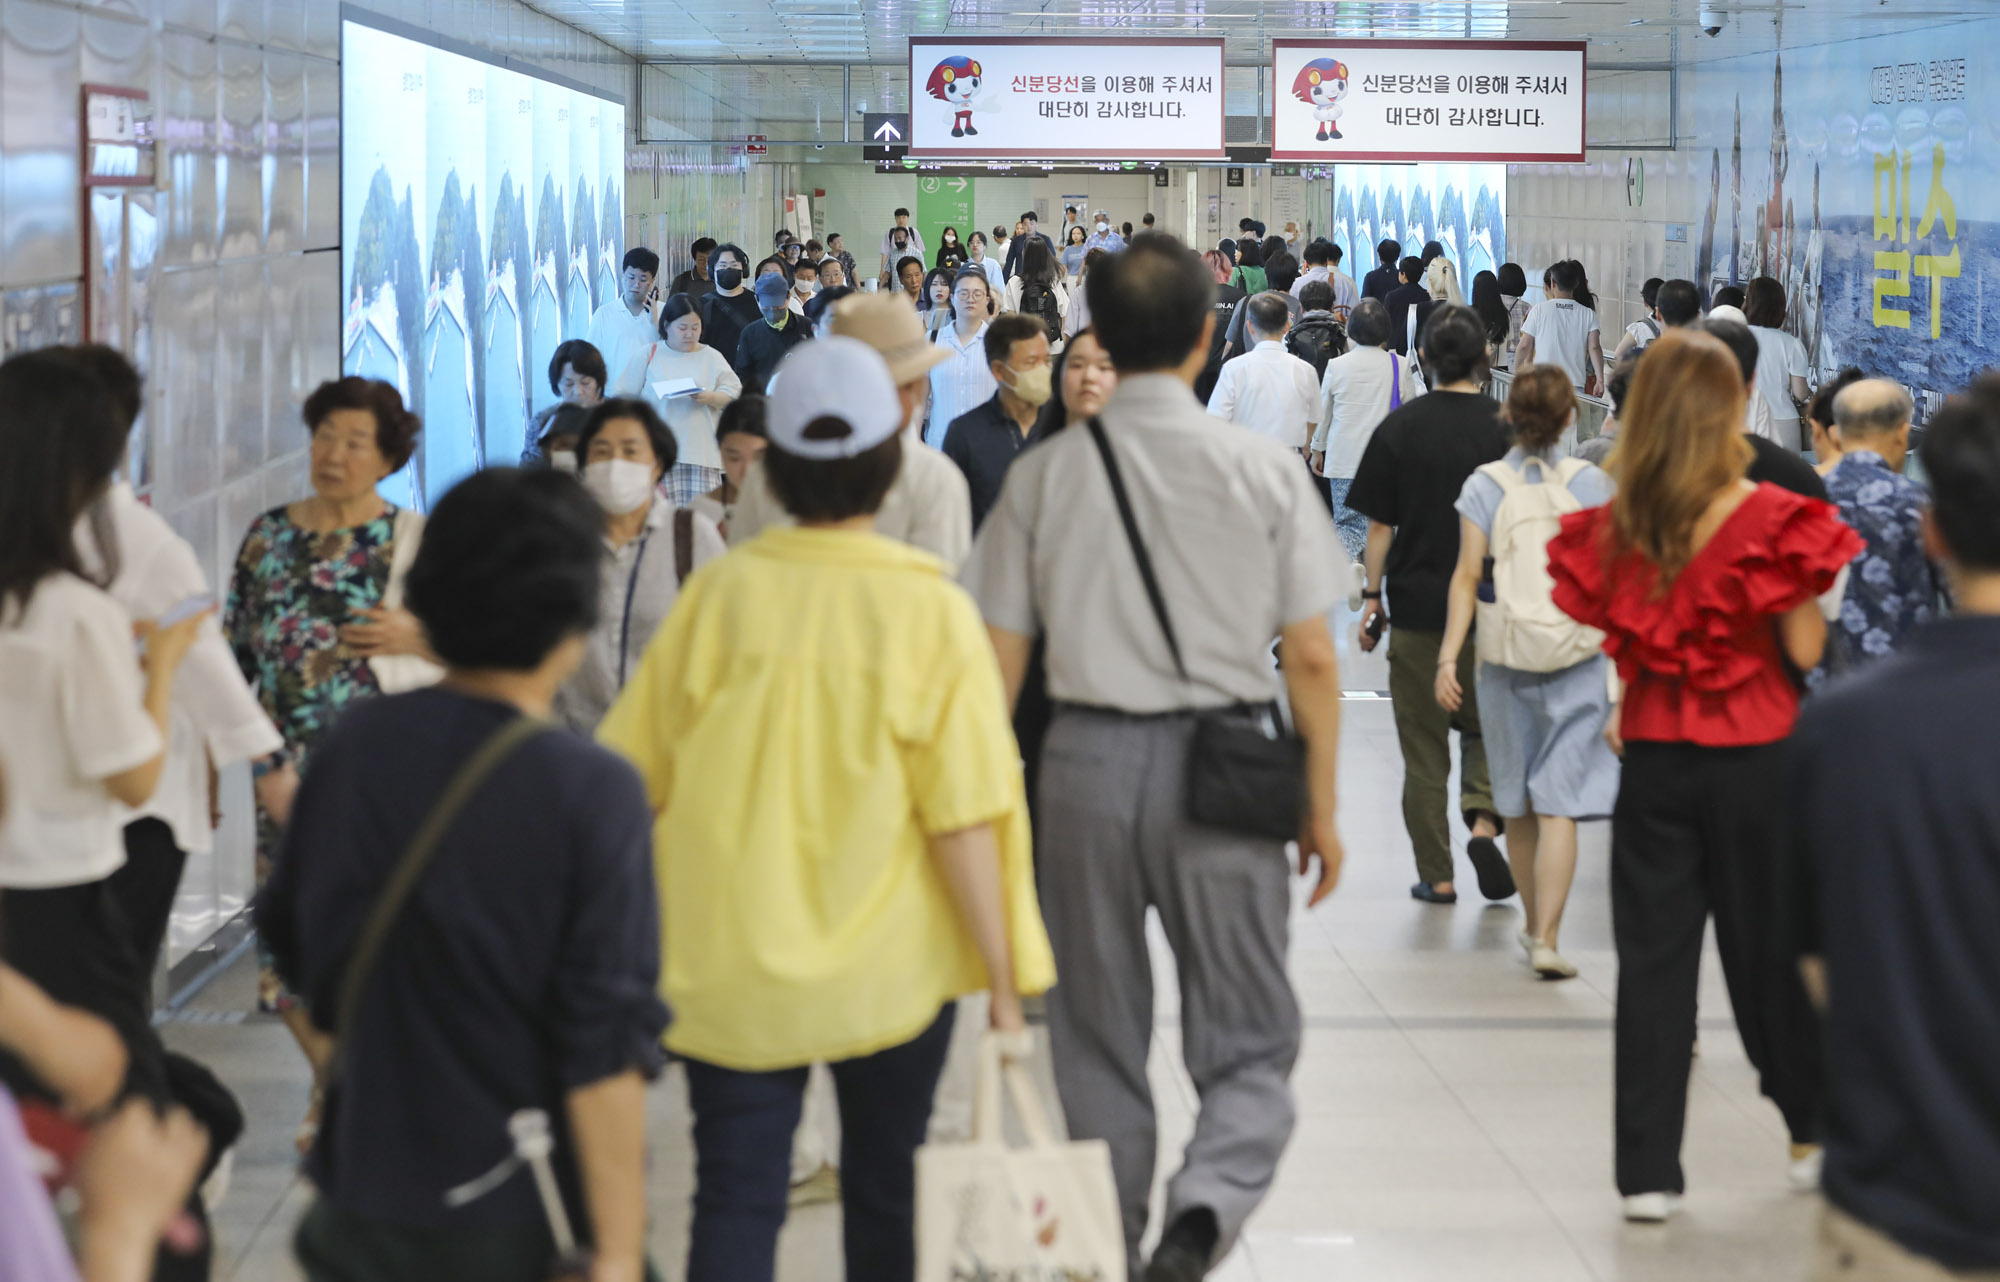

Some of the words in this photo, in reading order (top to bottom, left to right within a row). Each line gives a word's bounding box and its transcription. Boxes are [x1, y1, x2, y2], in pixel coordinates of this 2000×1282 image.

[1011, 75, 1097, 93] 신분당선을
[1104, 75, 1154, 94] 이용해
[1162, 76, 1212, 94] 주셔서
[1362, 74, 1451, 94] 신분당선을
[1457, 75, 1509, 95] 이용해
[1515, 76, 1567, 95] 주셔서
[1039, 101, 1088, 118] 대단히
[1097, 101, 1187, 119] 감사합니다.
[1386, 107, 1439, 126] 대단히
[1448, 108, 1544, 128] 감사합니다.
[1873, 141, 1961, 339] 밀수
